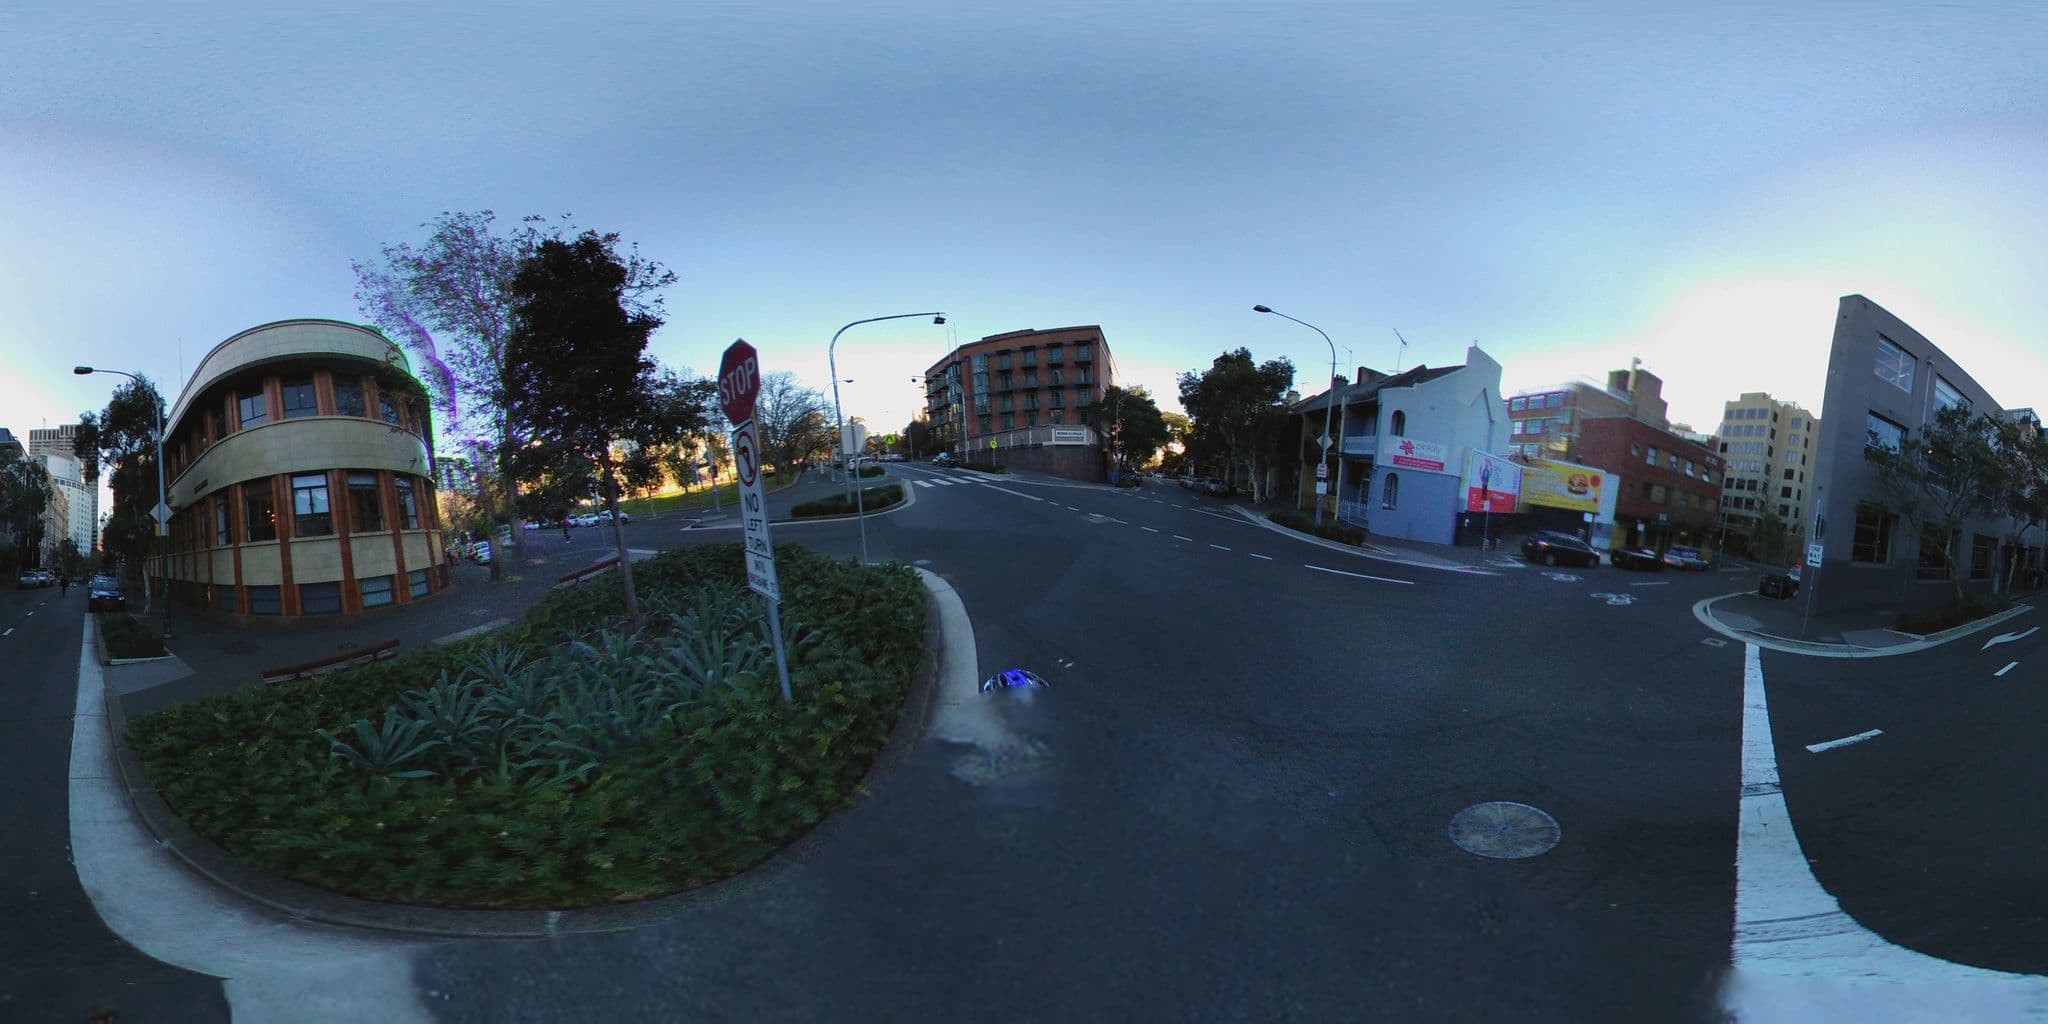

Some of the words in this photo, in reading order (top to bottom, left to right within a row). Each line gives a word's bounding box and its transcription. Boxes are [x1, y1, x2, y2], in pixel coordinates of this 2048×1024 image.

[720, 357, 756, 406] STOP
[744, 492, 760, 513] NO
[746, 518, 763, 533] LEFT
[748, 536, 769, 554] TURN
[1810, 552, 1821, 560] WAY
